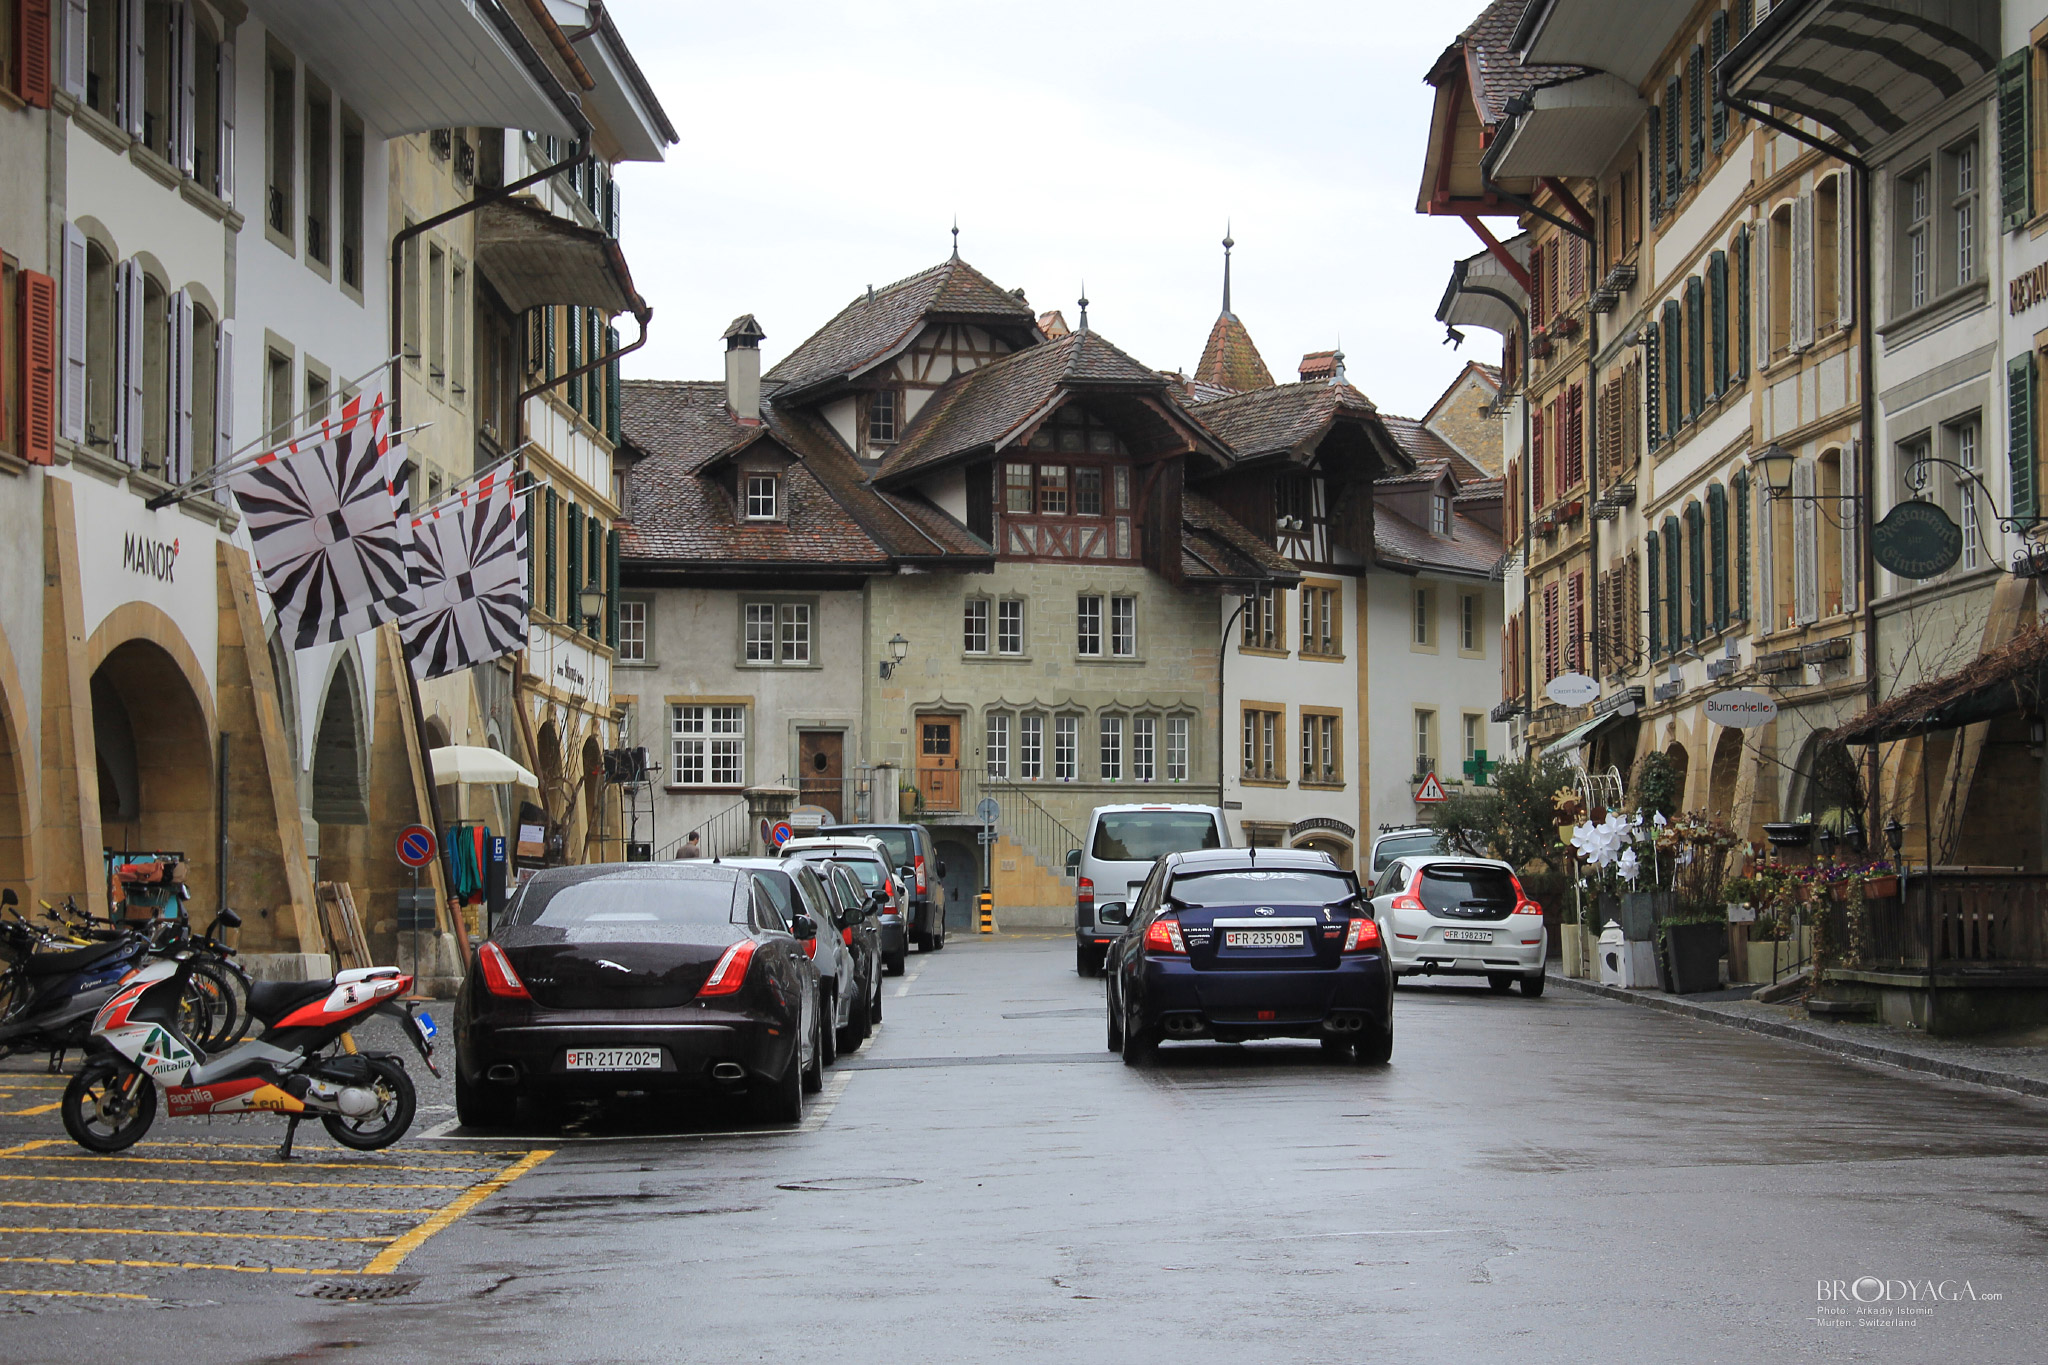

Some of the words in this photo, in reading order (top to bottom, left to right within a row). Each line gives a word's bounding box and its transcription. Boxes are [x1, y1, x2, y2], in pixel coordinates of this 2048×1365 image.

[123, 530, 174, 584] MANOR
[1707, 700, 1774, 713] Blumenkeller
[419, 1018, 434, 1035] L
[151, 1059, 192, 1076] Alitalia
[169, 1088, 215, 1105] aprilia
